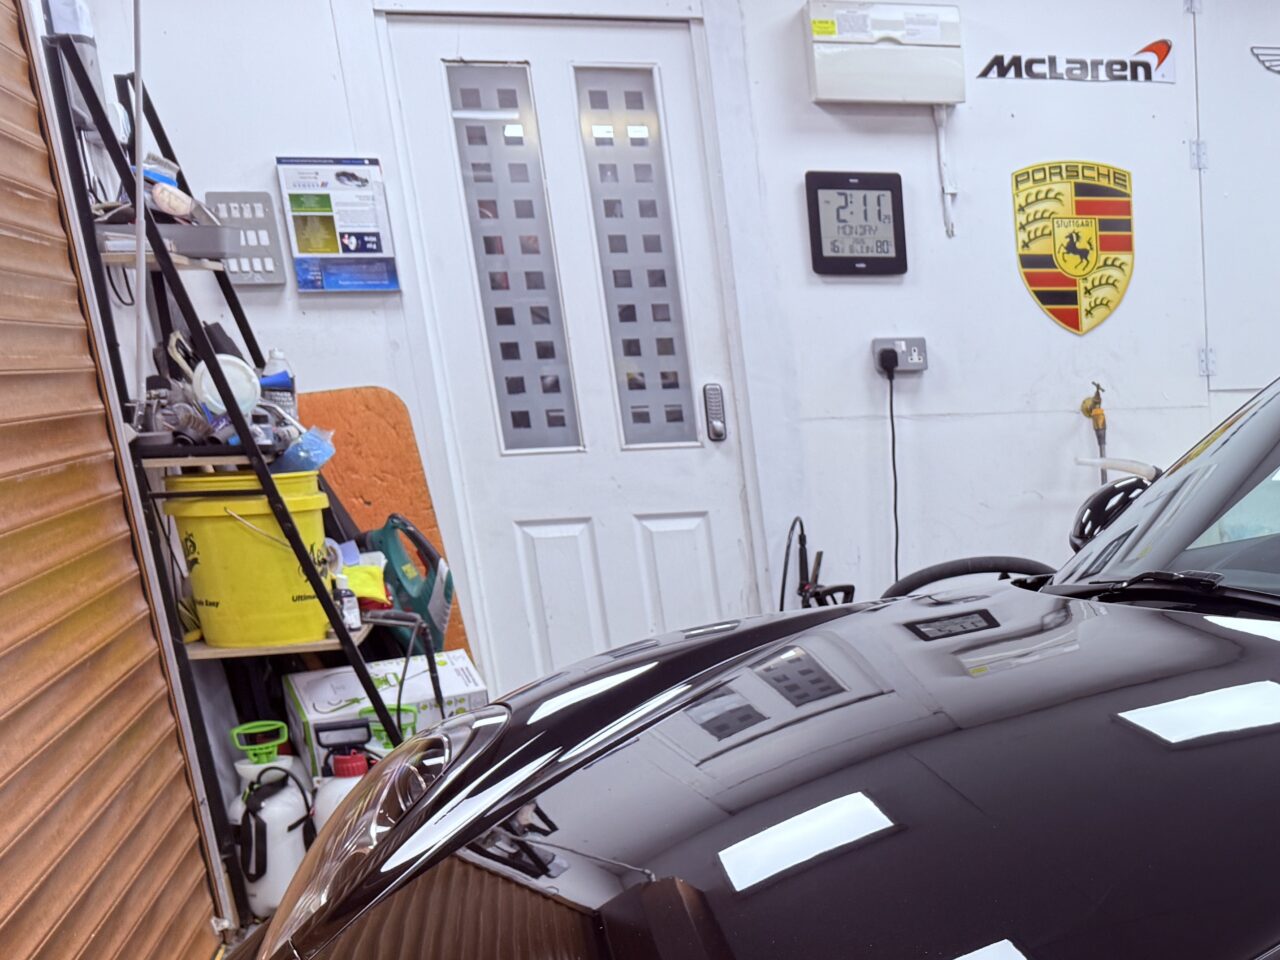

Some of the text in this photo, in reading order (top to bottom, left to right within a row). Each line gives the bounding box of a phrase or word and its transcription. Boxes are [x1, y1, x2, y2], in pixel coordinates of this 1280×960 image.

[976, 54, 1152, 81] McLaren
[1015, 165, 1128, 190] PORSCHE
[836, 224, 878, 236] MONDAY
